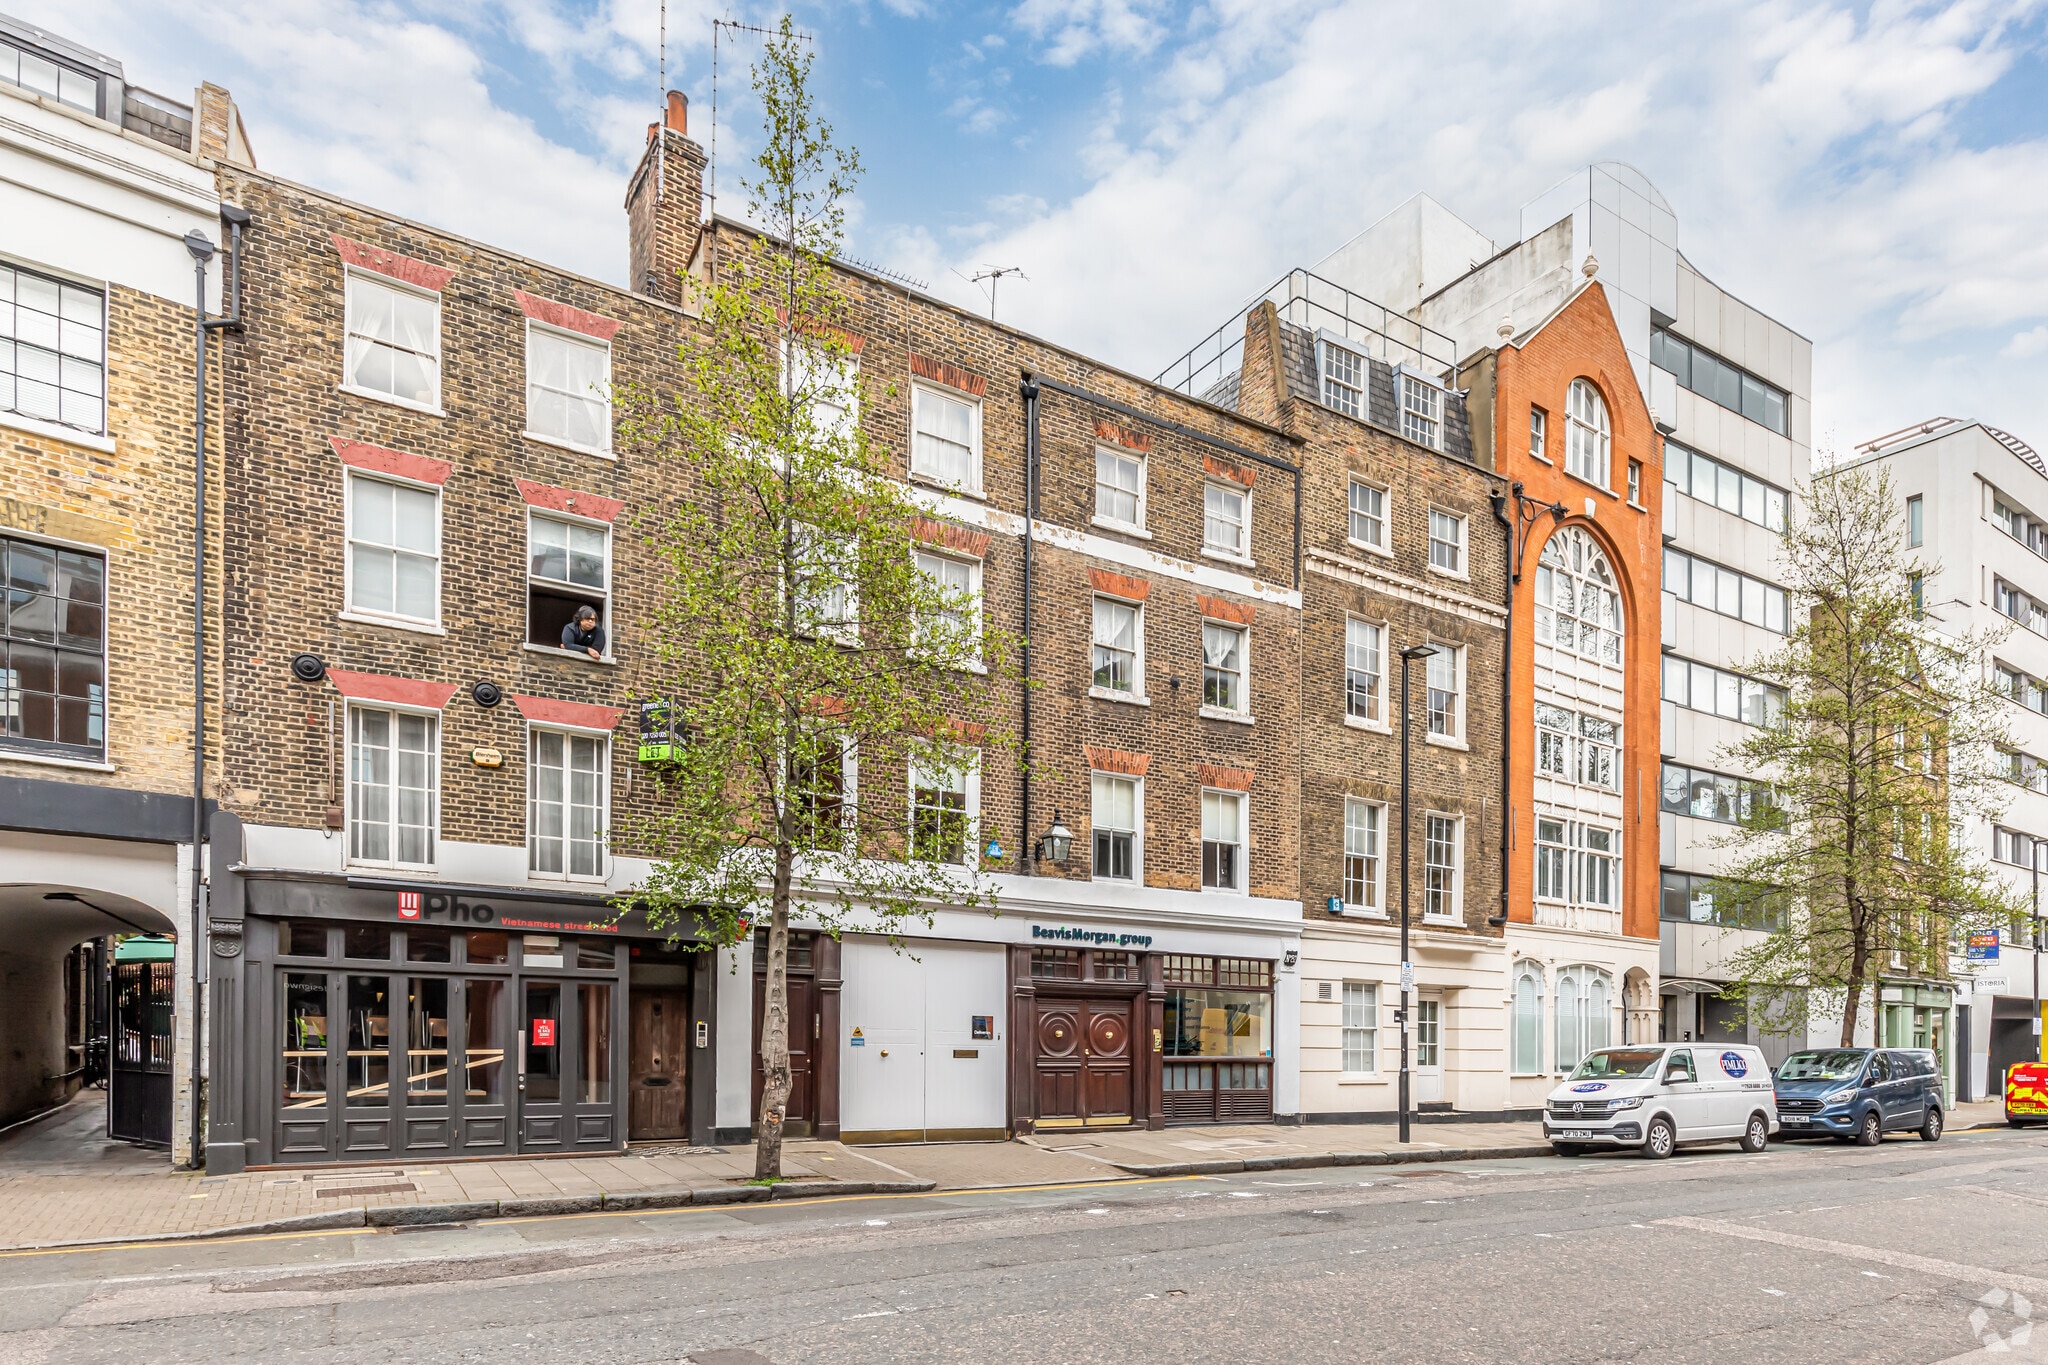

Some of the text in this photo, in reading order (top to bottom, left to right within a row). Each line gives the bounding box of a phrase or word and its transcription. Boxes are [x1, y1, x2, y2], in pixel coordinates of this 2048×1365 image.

[646, 747, 661, 758] LET
[423, 892, 494, 923] Pho
[501, 917, 561, 930] Vietnamese
[595, 923, 619, 933] ood
[1032, 925, 1153, 949] BeavisMorgan.group
[1722, 1060, 1747, 1070] PIMLICO
